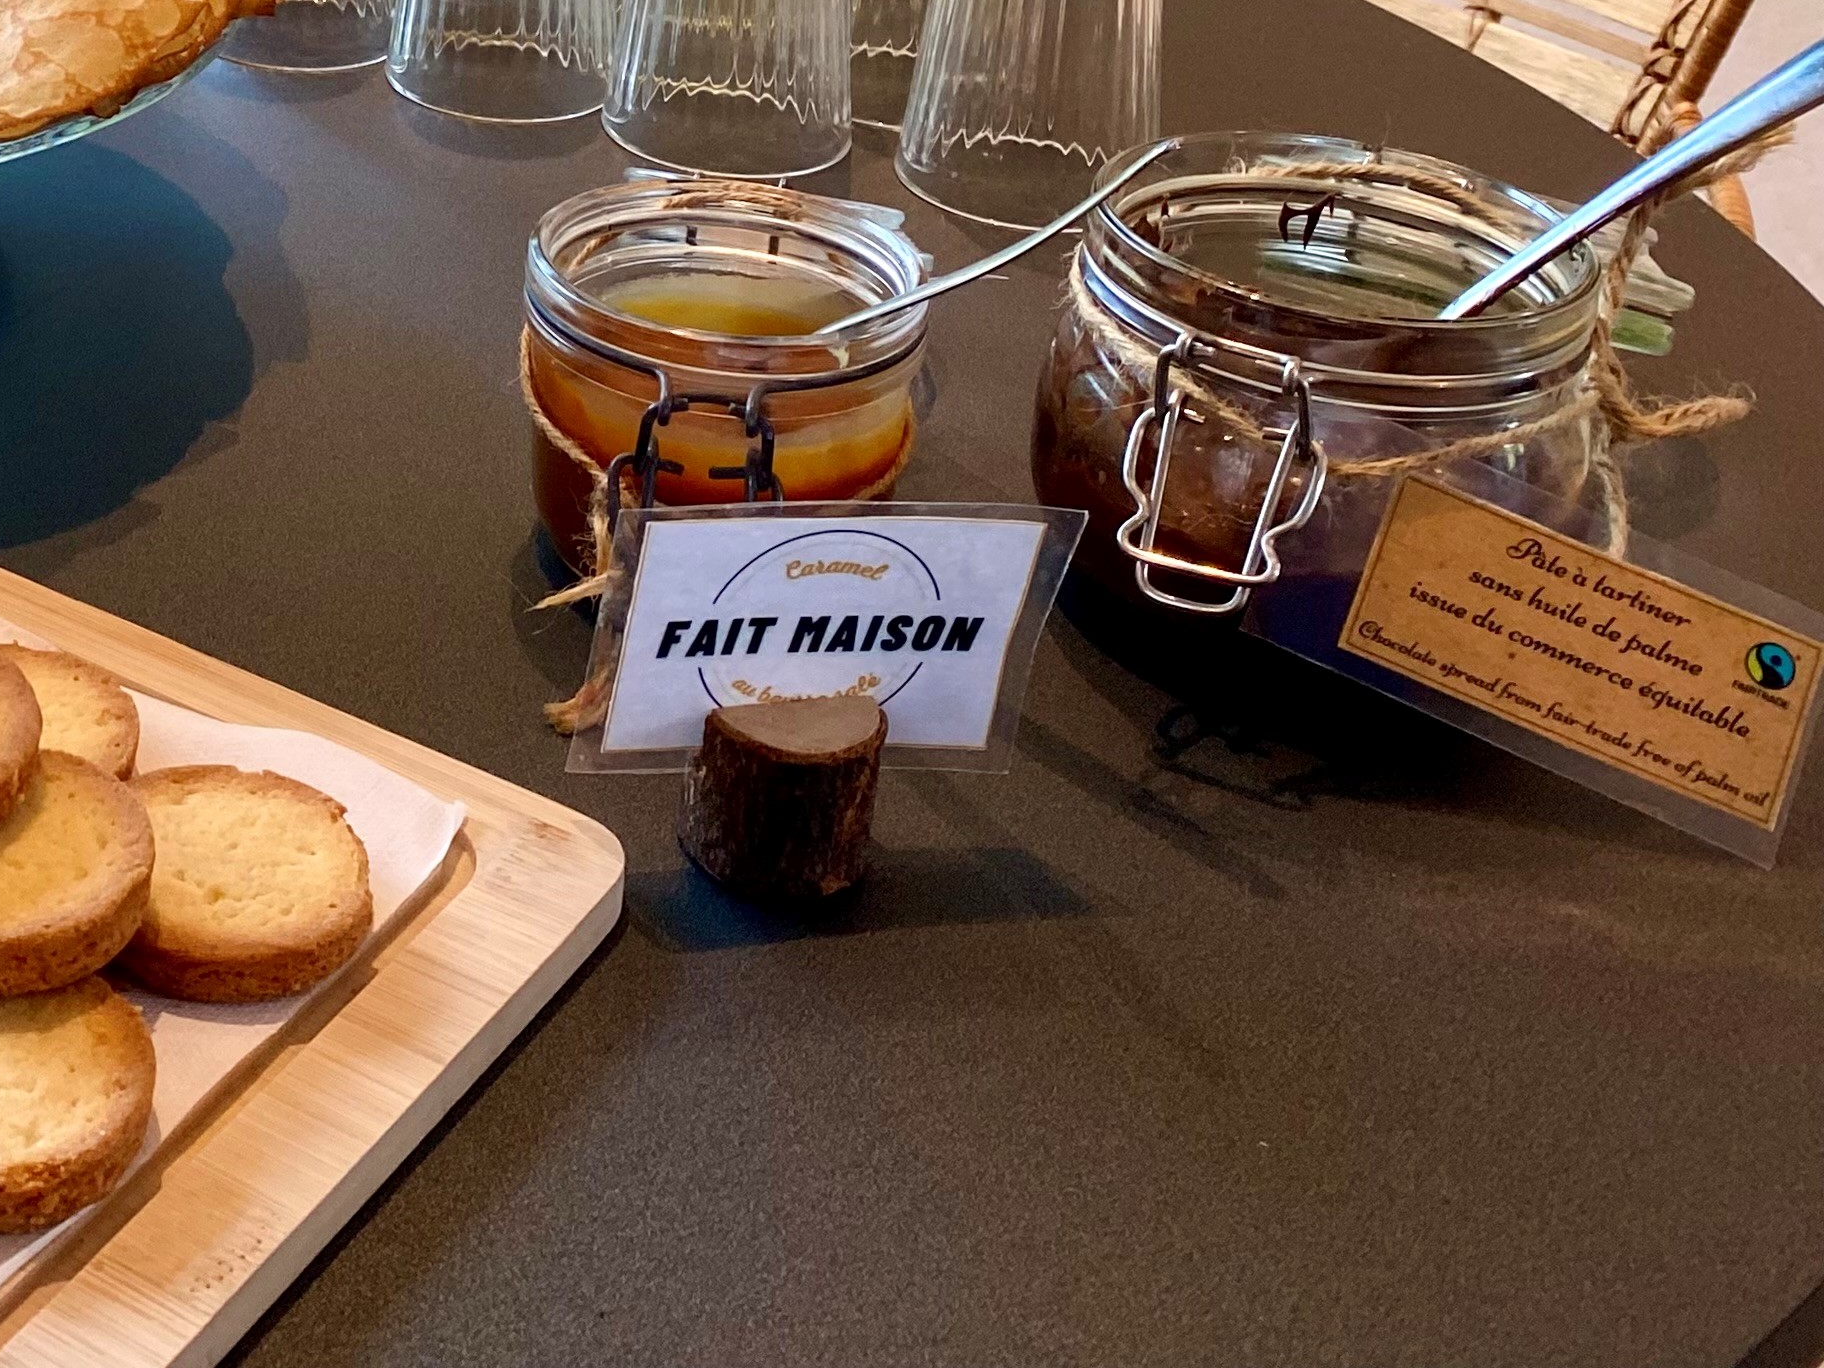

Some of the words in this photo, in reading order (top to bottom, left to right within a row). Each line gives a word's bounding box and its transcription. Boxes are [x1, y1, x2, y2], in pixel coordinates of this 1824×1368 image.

[786, 560, 889, 580] Caramel
[1572, 567, 1587, 586] à
[1593, 576, 1691, 626] tartiner
[656, 617, 778, 659] FAIT
[787, 615, 985, 653] MAISON
[1409, 581, 1467, 619] issue
[1472, 607, 1503, 635] du
[1508, 630, 1633, 690] commerce
[1638, 682, 1750, 738] équitable
[1468, 571, 1524, 601] sans
[1527, 586, 1587, 628] huile
[1591, 617, 1621, 642] de
[1618, 634, 1703, 676] palme
[1358, 620, 1436, 666] Chocolate
[1439, 663, 1502, 692] spread
[1495, 683, 1542, 712] from
[1631, 740, 1672, 766] free
[1674, 760, 1702, 776] of
[1692, 764, 1740, 796] palm
